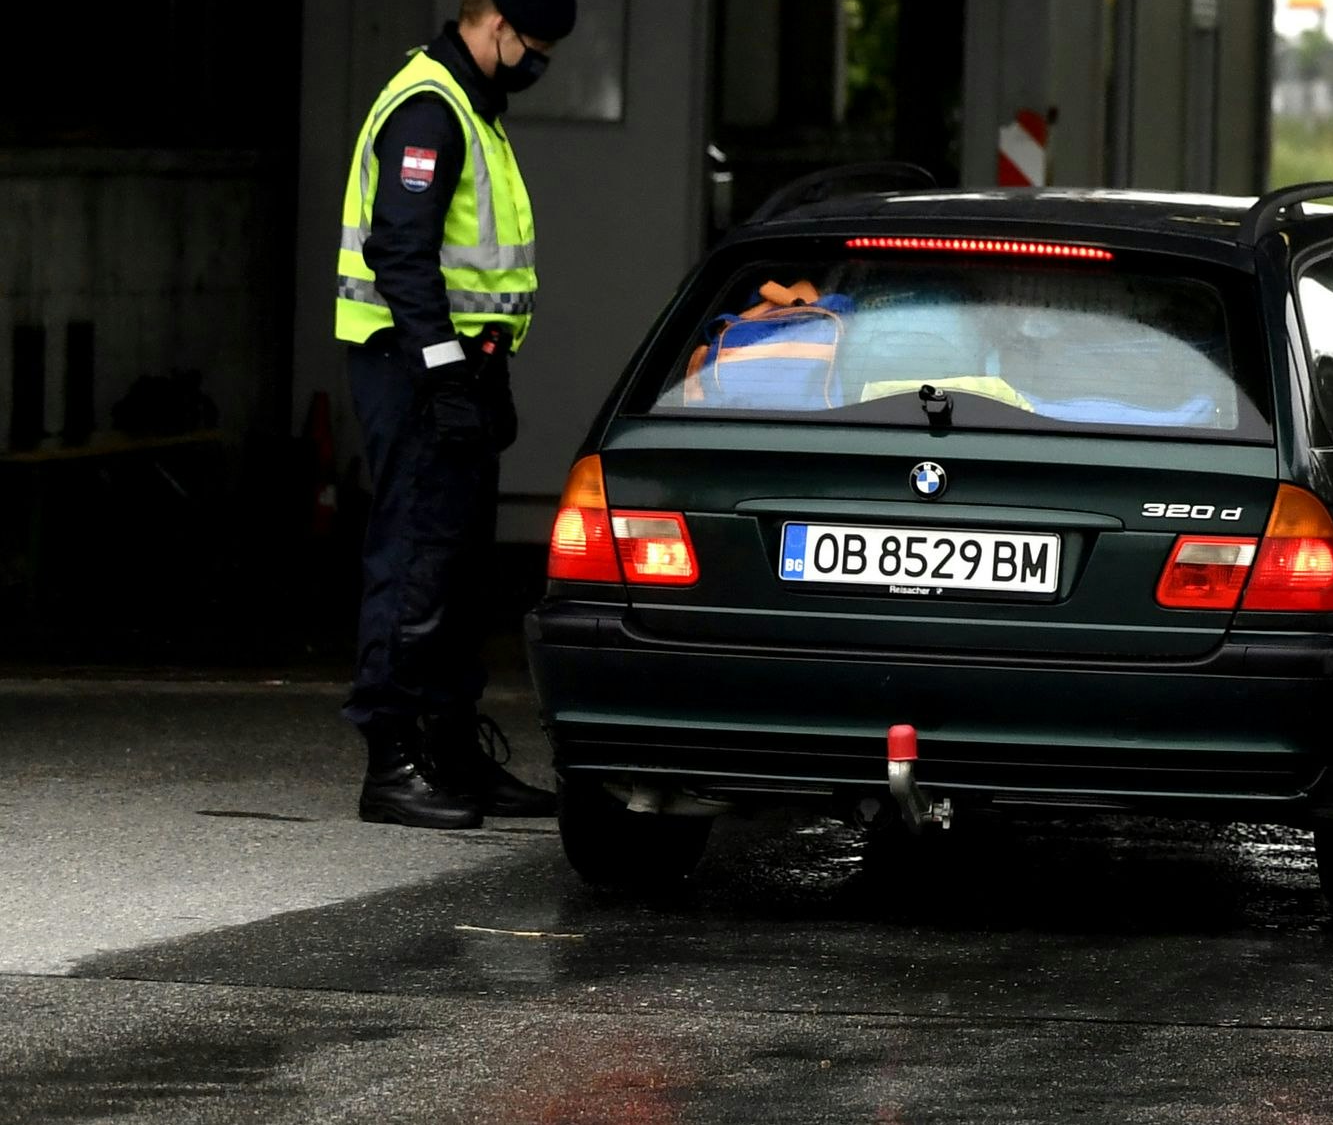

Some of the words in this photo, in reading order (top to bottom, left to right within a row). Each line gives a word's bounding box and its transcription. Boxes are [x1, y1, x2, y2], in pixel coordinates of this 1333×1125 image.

[784, 558, 804, 572] BG
[813, 533, 868, 575] OB
[878, 535, 983, 581] 8529
[992, 540, 1049, 584] BM
